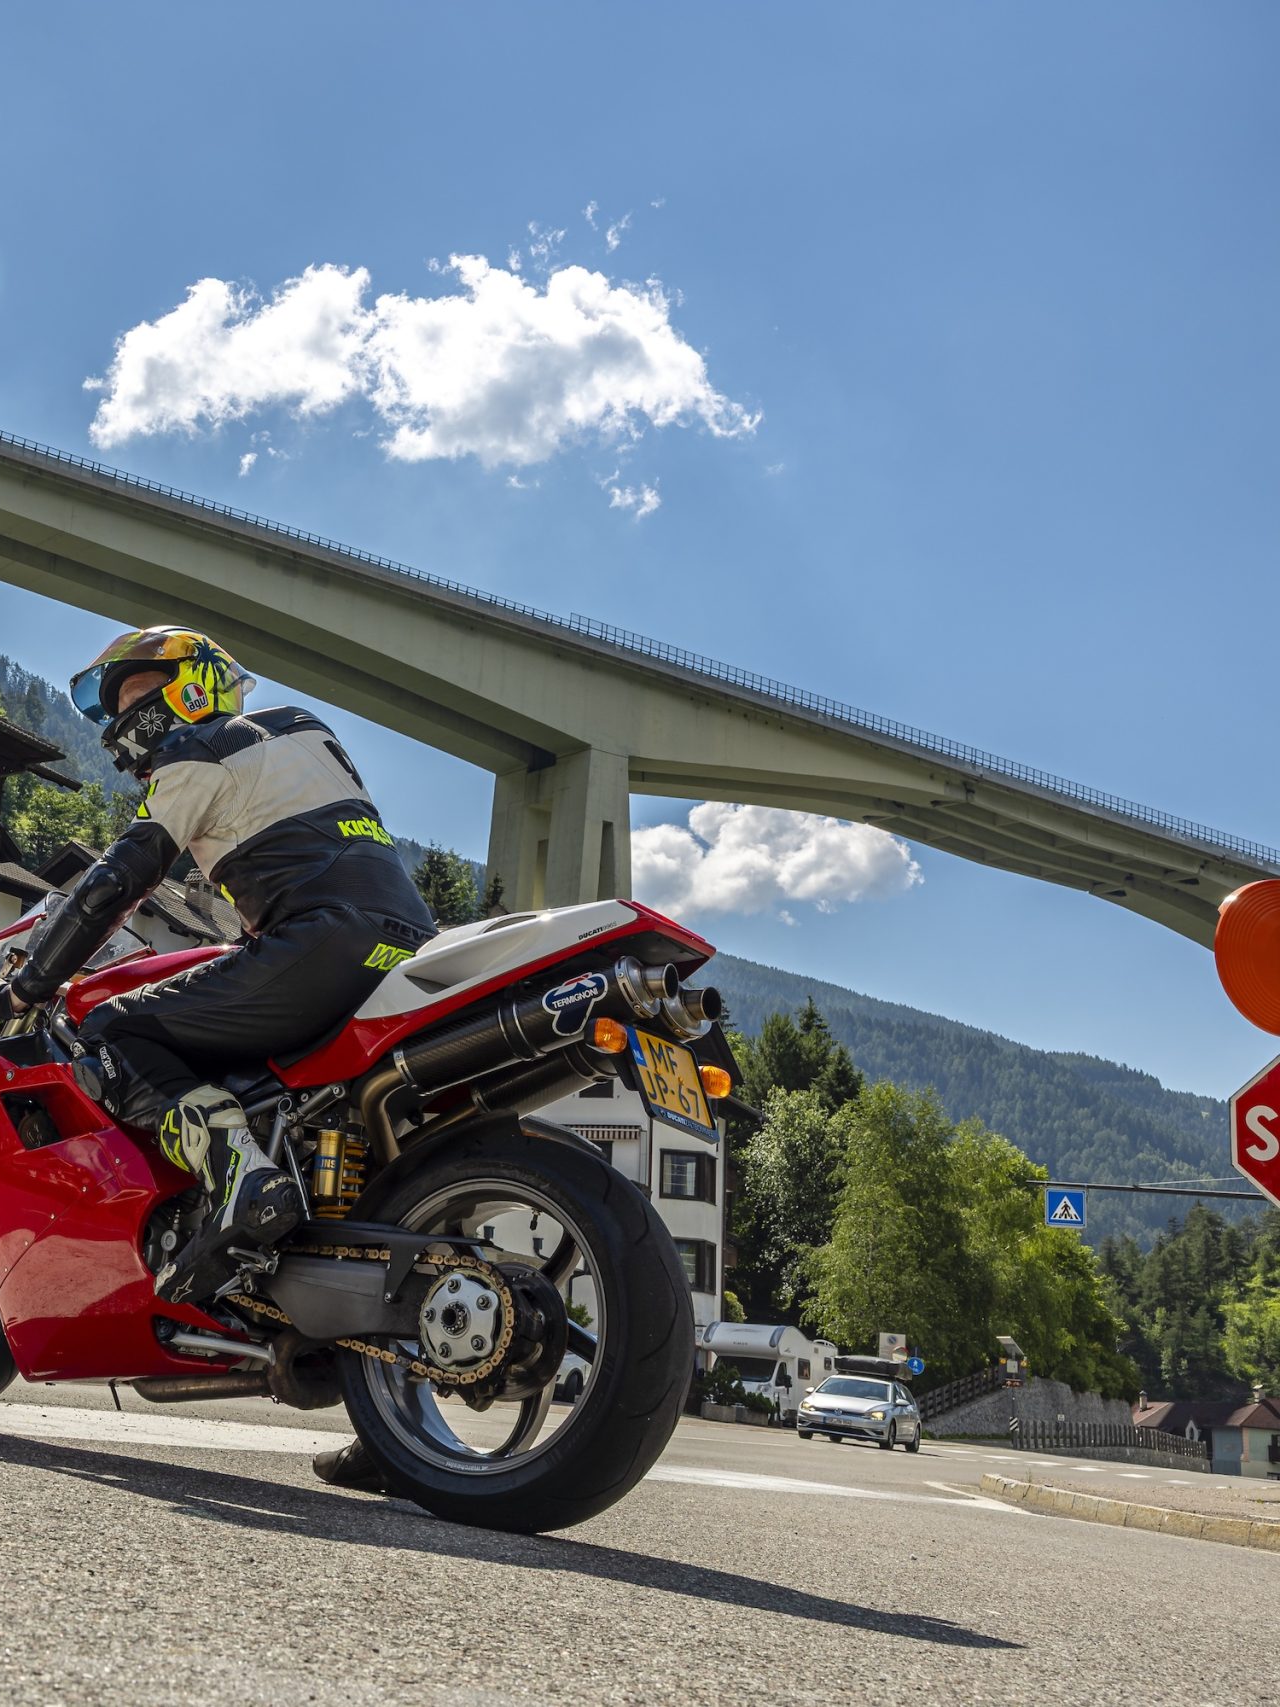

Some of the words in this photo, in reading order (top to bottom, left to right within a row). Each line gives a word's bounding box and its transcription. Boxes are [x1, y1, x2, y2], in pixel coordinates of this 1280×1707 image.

[188, 696, 207, 711] agv
[578, 926, 604, 940] DUCATI
[552, 987, 599, 1009] TERMIGNONI
[646, 1037, 678, 1075] MF
[1245, 1104, 1280, 1162] S
